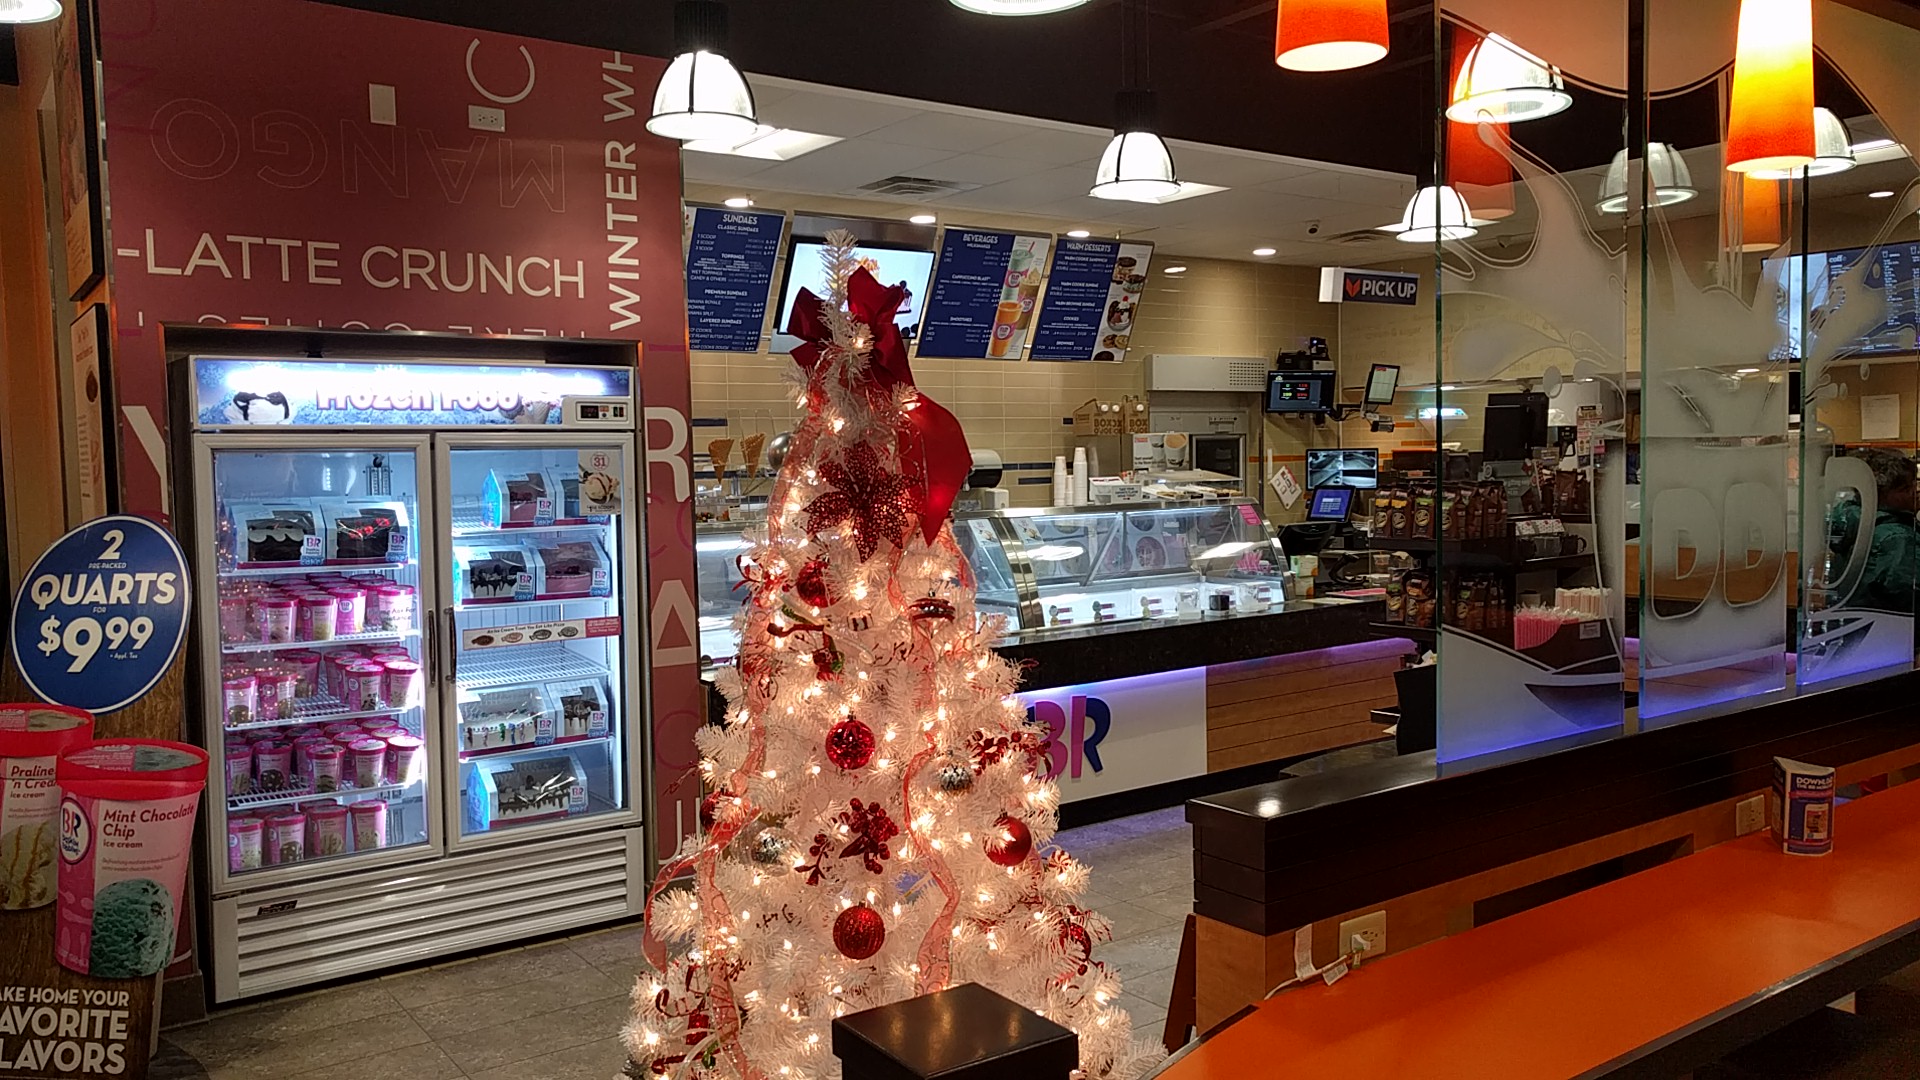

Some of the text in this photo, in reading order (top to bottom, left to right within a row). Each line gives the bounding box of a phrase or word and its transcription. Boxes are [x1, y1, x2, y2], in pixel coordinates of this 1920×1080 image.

[723, 214, 758, 225] SUNDAES
[604, 139, 641, 331] WINTER
[963, 234, 999, 243] BEVERAGES
[1066, 242, 1111, 252] WARM DESSERTS
[360, 245, 585, 298] CRUNCH
[1362, 280, 1416, 298] PICK UP
[594, 457, 606, 467] 31
[98, 529, 125, 560] 2
[31, 572, 177, 611] QUARTS
[11, 765, 56, 777] Praline
[25, 778, 56, 789] Crea
[10, 790, 21, 798] ice
[104, 803, 195, 823] Mint Chocolate
[62, 808, 81, 838] BR
[103, 823, 135, 840] Chip
[103, 839, 143, 849] ice cream
[29, 987, 79, 1005] HOME
[82, 989, 130, 1007] YOUR
[0, 1005, 129, 1040] AVORITE
